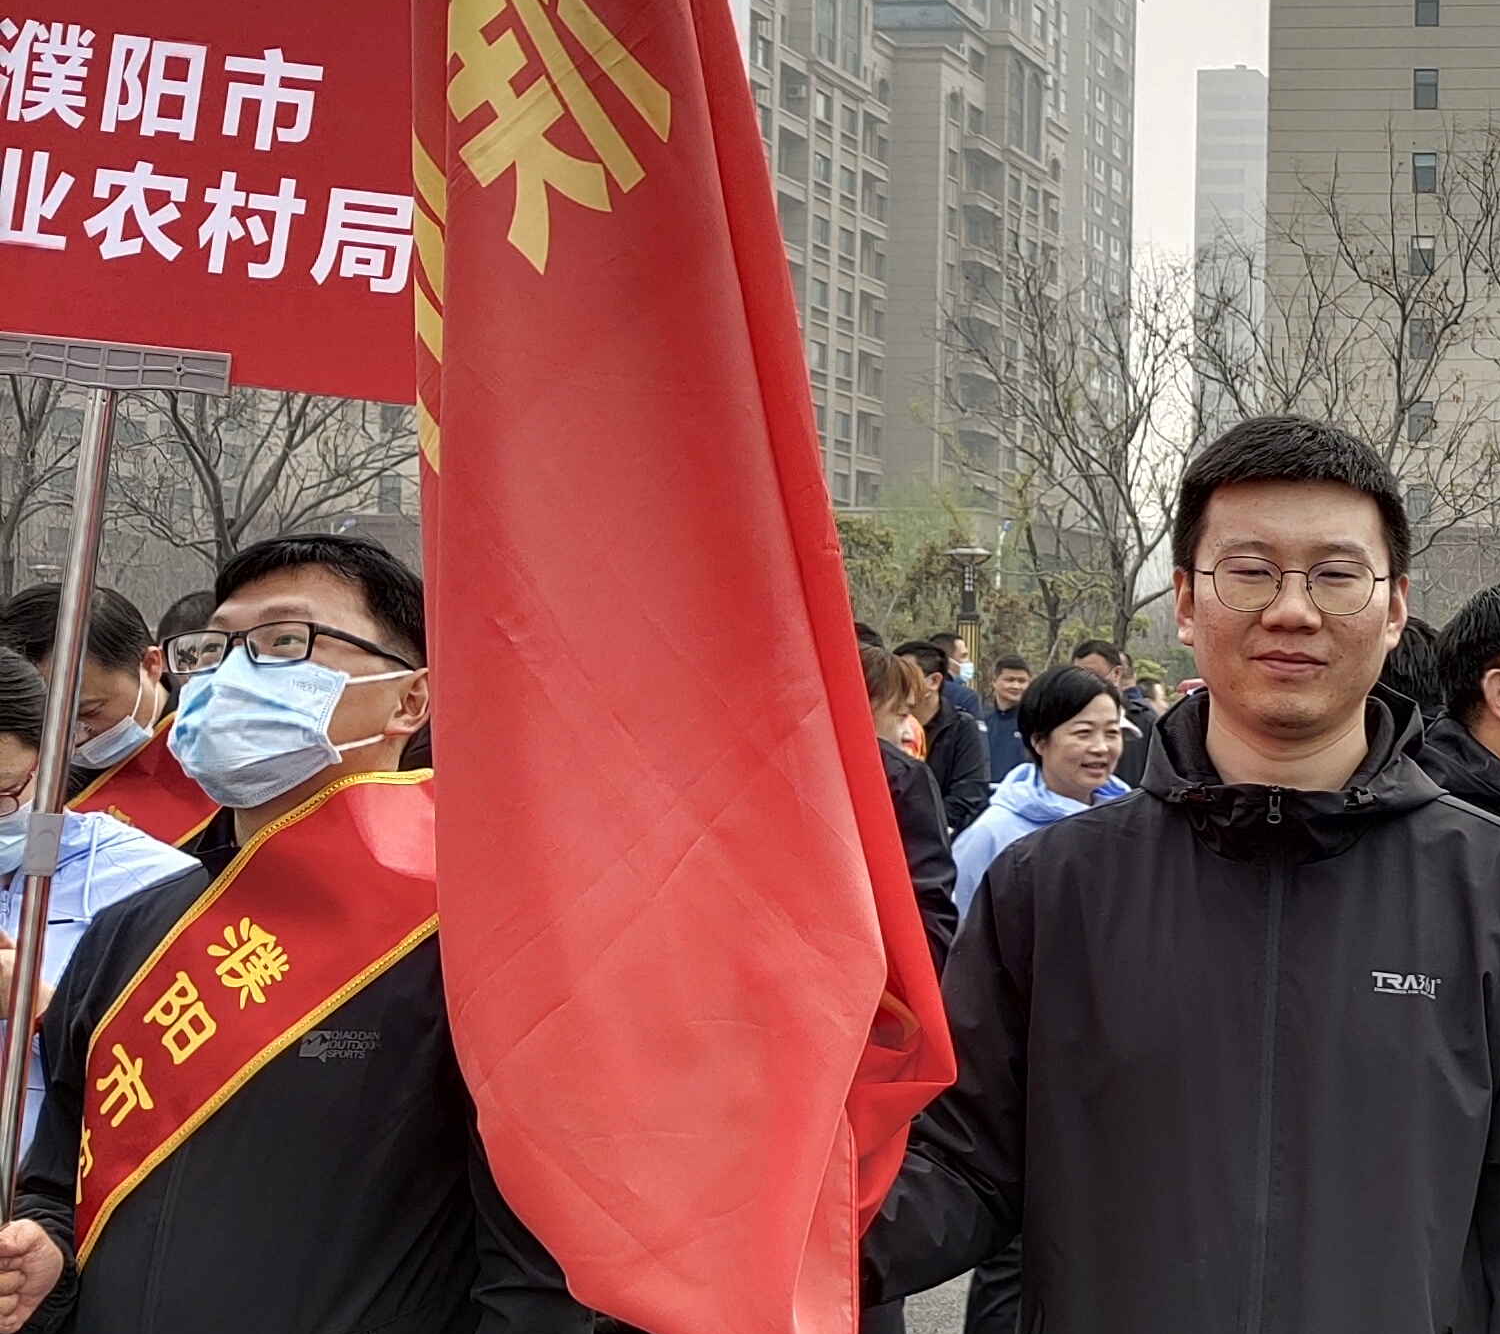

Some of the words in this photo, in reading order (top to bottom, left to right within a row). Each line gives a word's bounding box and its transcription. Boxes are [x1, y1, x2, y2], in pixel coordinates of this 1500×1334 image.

[0, 16, 325, 152] 濮阳市
[329, 1040, 380, 1050] OUTDOO
